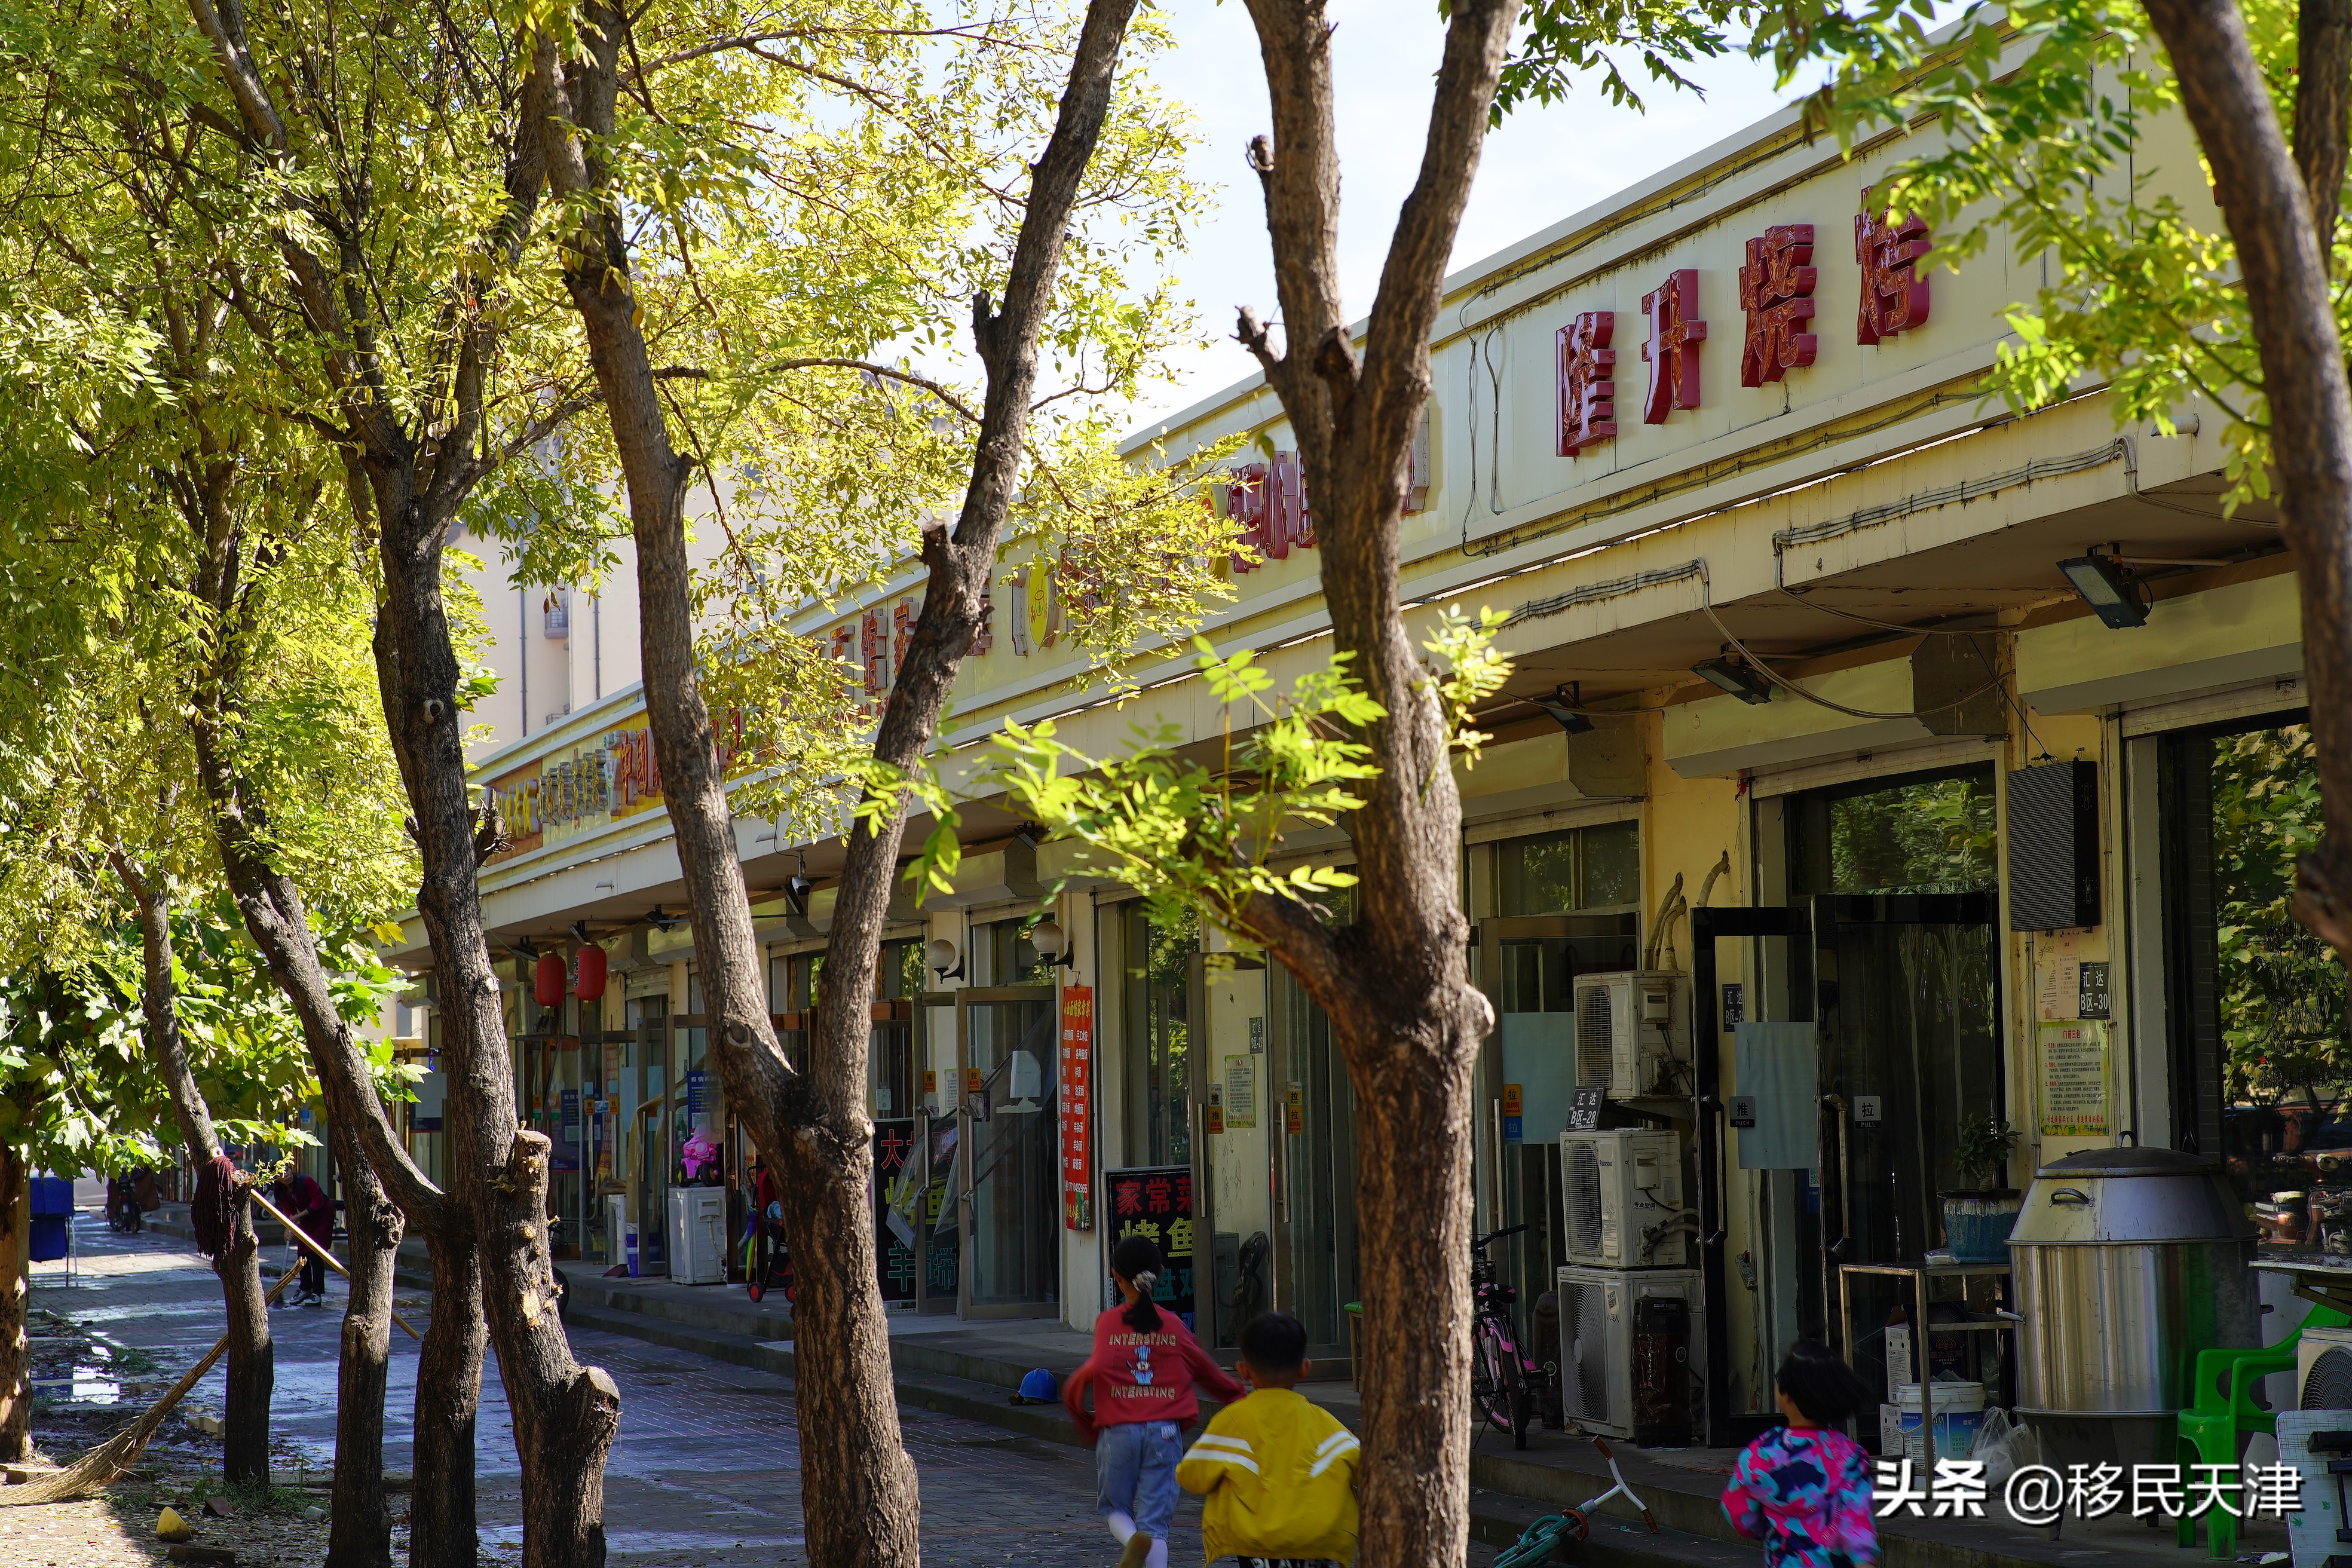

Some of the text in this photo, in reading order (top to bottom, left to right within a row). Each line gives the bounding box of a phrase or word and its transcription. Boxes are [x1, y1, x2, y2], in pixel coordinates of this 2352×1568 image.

[1555, 185, 1930, 457] 隆升烧烤
[2083, 969, 2104, 988] 汇达
[2081, 992, 2108, 1012] B区-30
[2063, 1029, 2081, 1039] 门前三包
[1211, 1094, 1220, 1102] 推
[1290, 1092, 1298, 1101] 拉
[1508, 1089, 1517, 1101] 拉
[1578, 1091, 1597, 1105] 汇达
[1212, 1111, 1220, 1120] 推
[1291, 1110, 1298, 1120] 拉
[1736, 1102, 1748, 1116] 推
[1861, 1102, 1875, 1117] 拉
[1570, 1110, 1597, 1125] B区-28
[1508, 1122, 1519, 1133] 拉
[1110, 1385, 1176, 1400] INTERSTING
